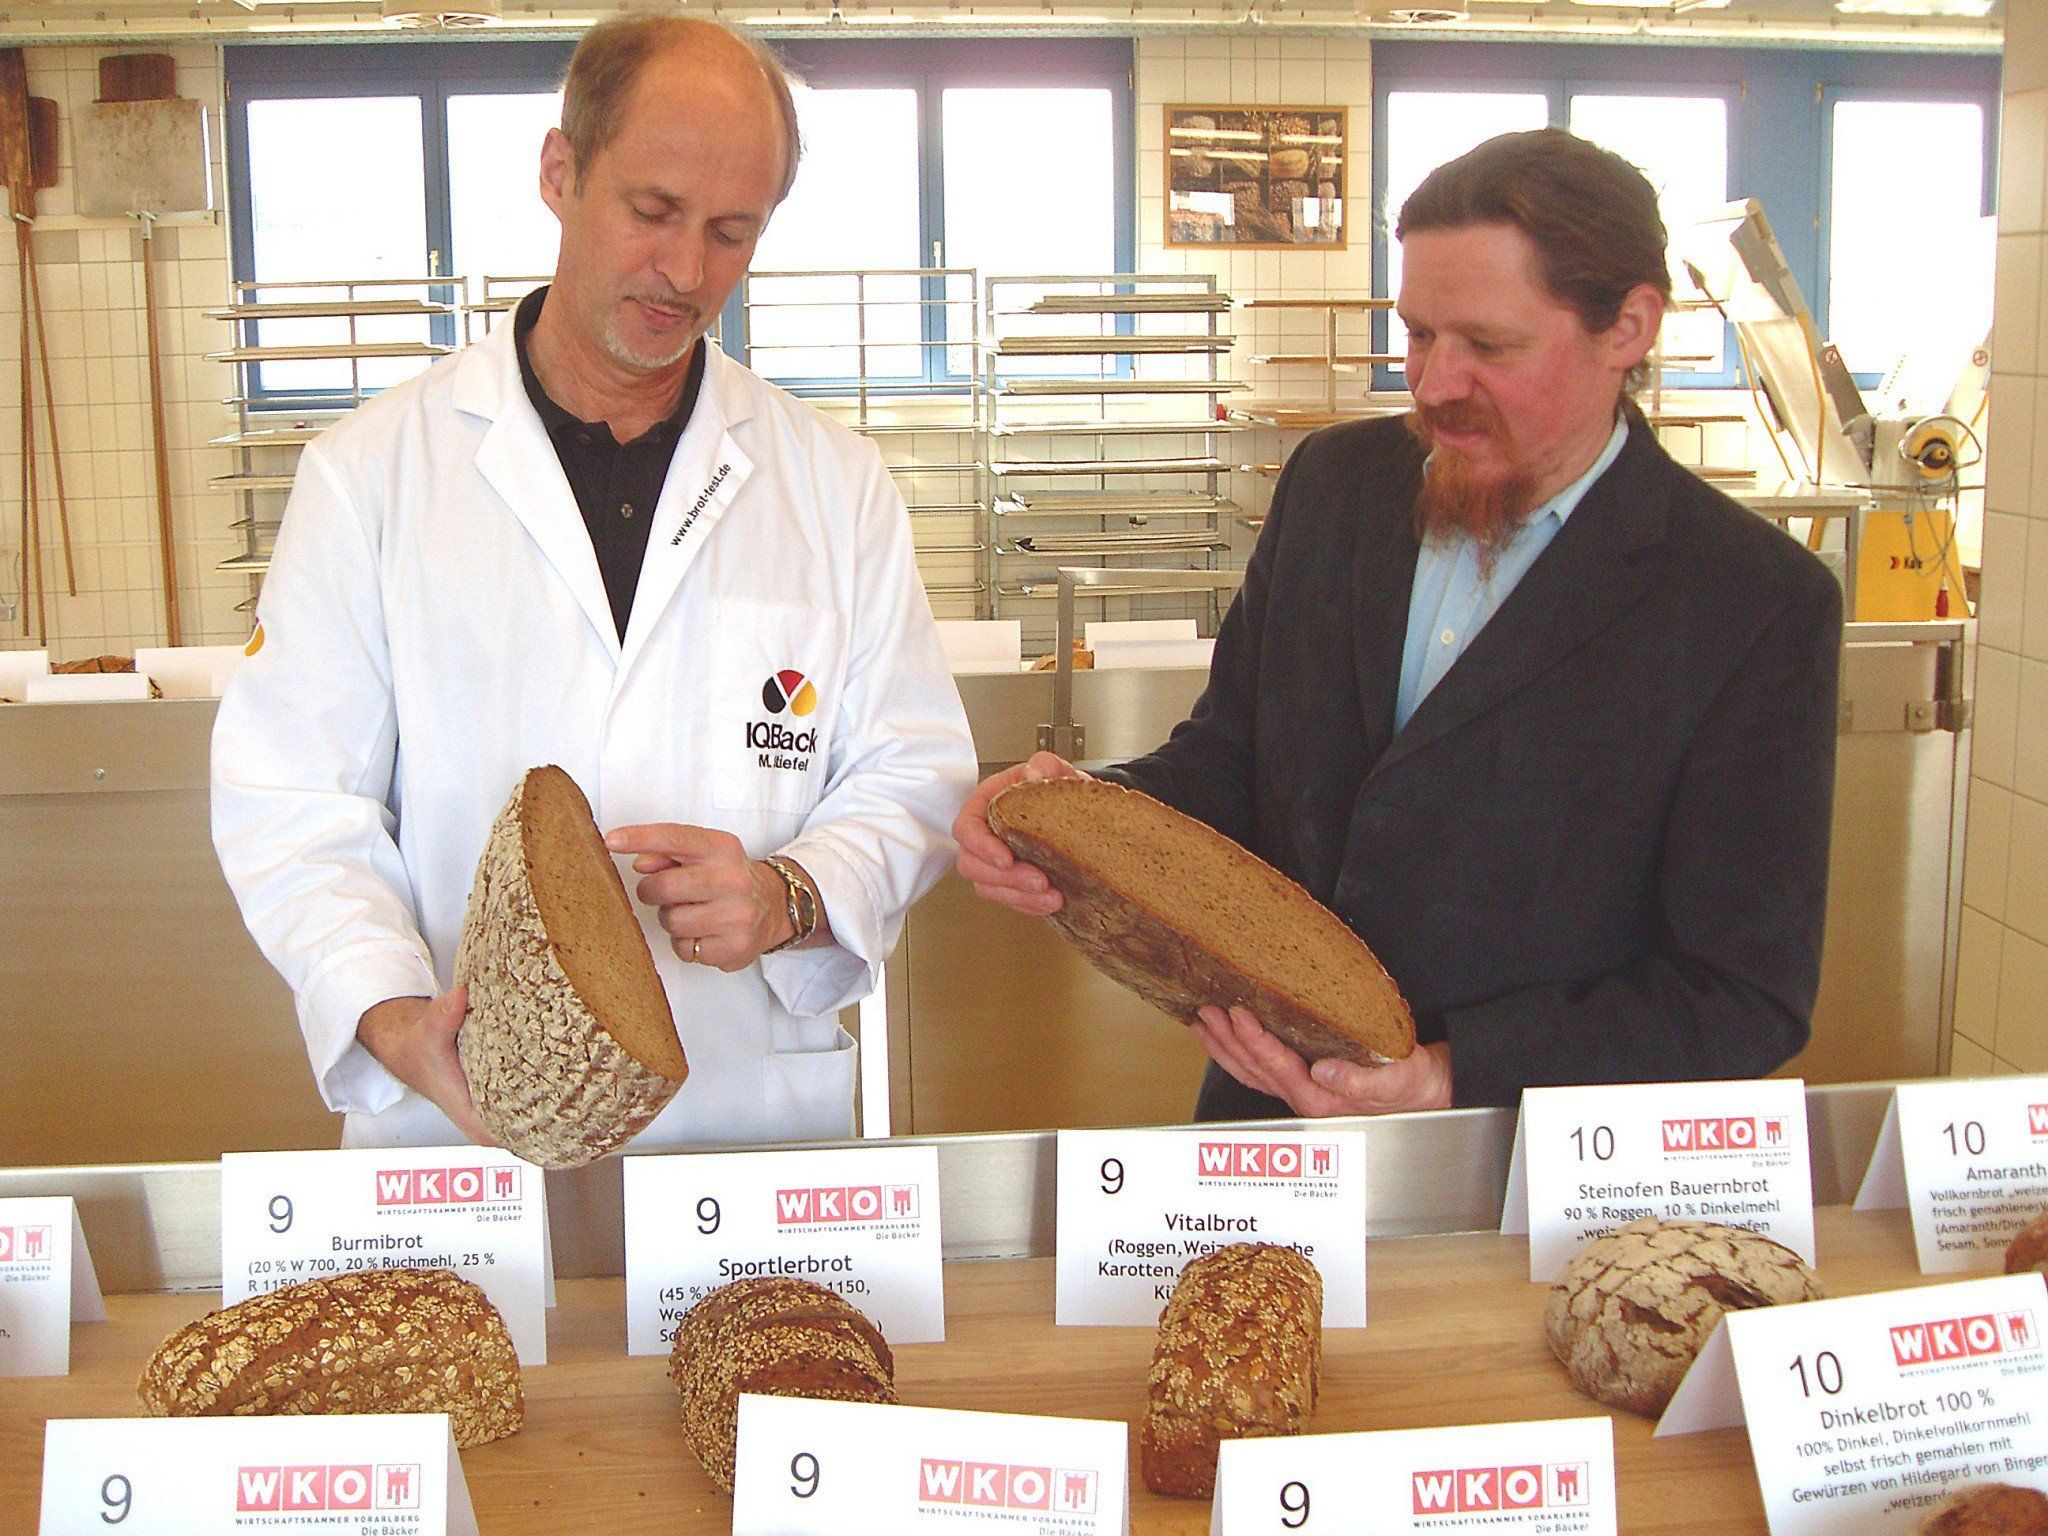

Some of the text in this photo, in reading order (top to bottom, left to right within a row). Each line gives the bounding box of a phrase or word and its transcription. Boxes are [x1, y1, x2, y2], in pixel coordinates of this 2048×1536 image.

[670, 464, 731, 546] www.brot-test.de
[746, 721, 818, 753] IQBack
[758, 754, 772, 768] M.
[1569, 1125, 1616, 1162] 10
[1662, 1119, 1755, 1149] WKO
[1943, 1121, 1986, 1156] 10
[1100, 1157, 1125, 1195] 9
[1199, 1146, 1299, 1174] WKO
[1966, 1162, 2047, 1181] Amaranth
[377, 1171, 481, 1201] WKO
[1579, 1178, 1769, 1200] Steinofen Bauernbrot
[268, 1194, 294, 1234] 9
[695, 1196, 721, 1236] 9
[777, 1188, 879, 1219] WKO
[1564, 1200, 1780, 1221] 90 % Roggen, 10 % Dinkelmehl
[1165, 1213, 1258, 1232] Vitalbrot
[332, 1234, 423, 1251] Burmibrot
[248, 1252, 495, 1275] (20 % W 700, 20 % Ruchmehl, 25 %
[718, 1255, 853, 1280] Sportlerbrot
[248, 1280, 257, 1291] R
[659, 1286, 684, 1304] (45
[689, 1286, 702, 1300] %
[1890, 1318, 1997, 1360] WKO
[1788, 1349, 1845, 1398] 10
[1820, 1387, 1995, 1430] Dinkelbrot 100 %
[1795, 1439, 1834, 1458] 100%
[1824, 1435, 2013, 1476] selbst frisch gemahlen mit
[239, 1468, 368, 1506] WKO
[789, 1452, 821, 1499] 9
[921, 1462, 1047, 1504] WKO
[1413, 1469, 1539, 1509] WKO
[1792, 1479, 1867, 1503] Gewürzen
[1871, 1476, 1898, 1492] von
[1901, 1463, 1971, 1488] Hildegard
[1974, 1461, 2001, 1476] von
[100, 1473, 133, 1525] 9
[1279, 1481, 1311, 1529] 9
[361, 1526, 419, 1536] Die Bäcker
[1535, 1525, 1552, 1534] Die
